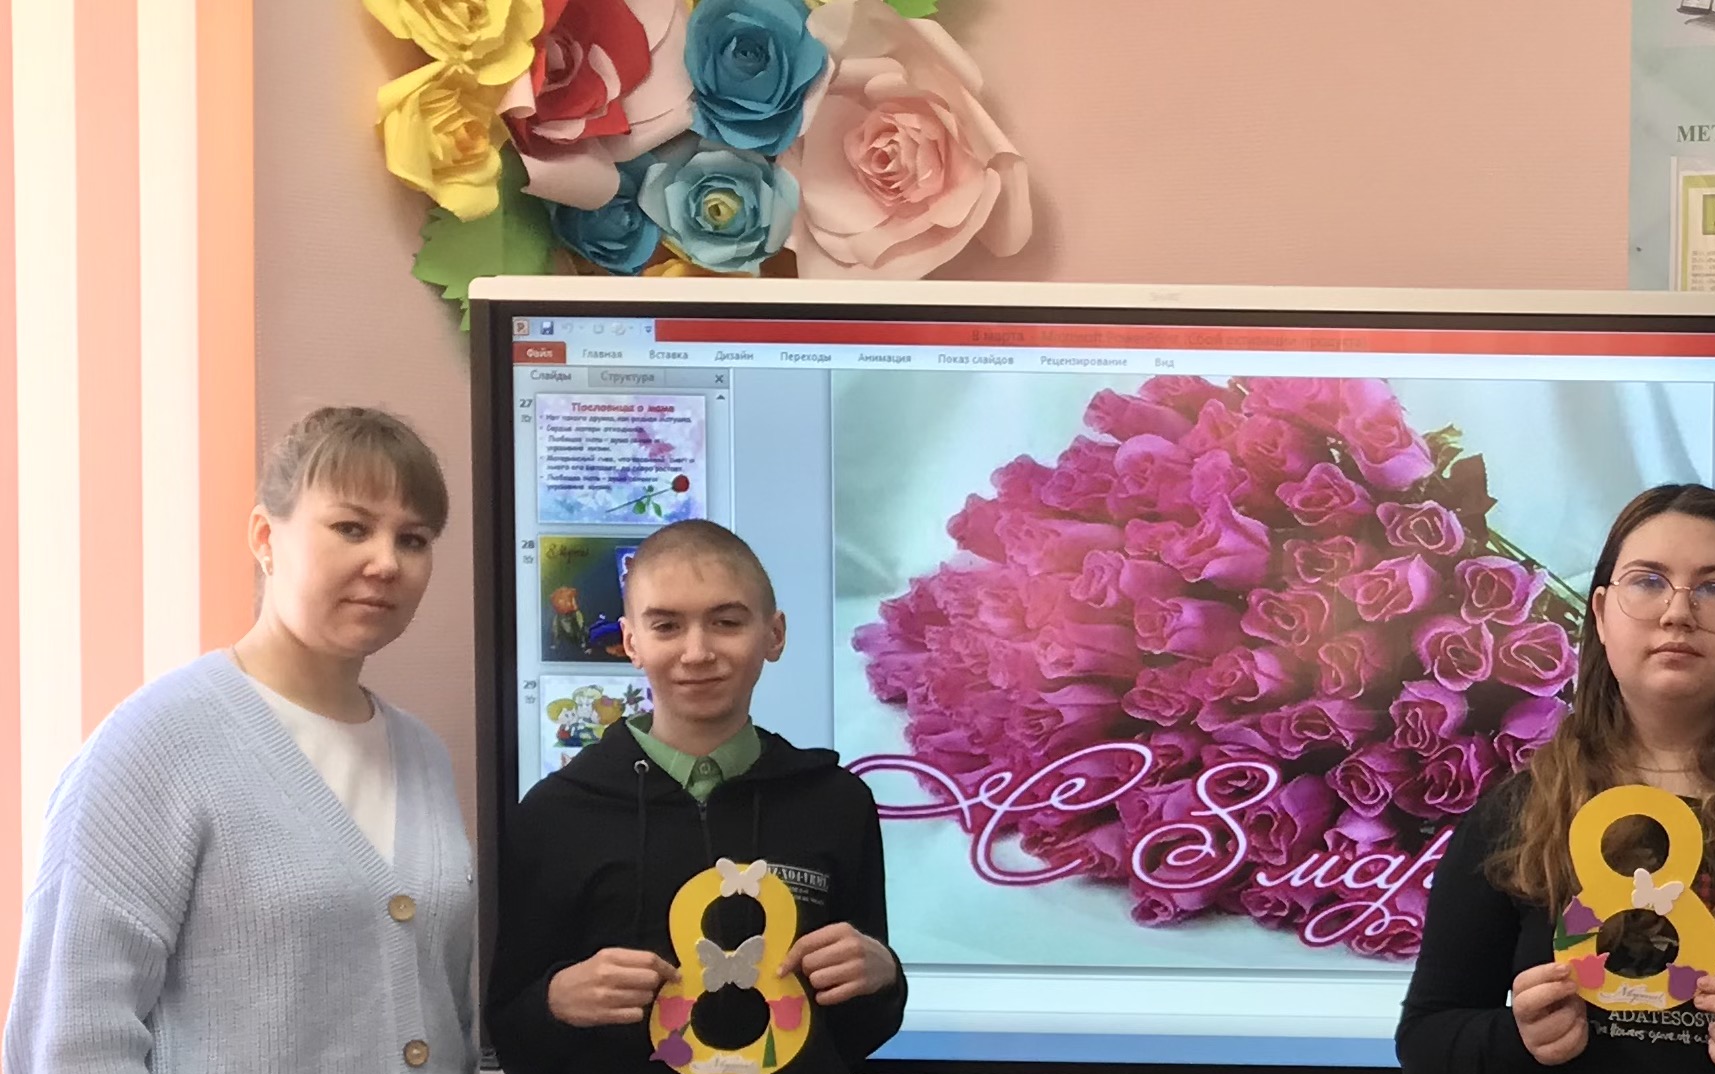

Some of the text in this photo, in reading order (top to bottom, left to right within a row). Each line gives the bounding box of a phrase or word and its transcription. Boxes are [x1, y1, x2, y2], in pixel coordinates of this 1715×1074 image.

[526, 347, 554, 359] Файл
[582, 348, 623, 360] Главная
[649, 349, 689, 361] Вставка
[714, 350, 754, 362] Дизайн
[780, 351, 832, 363] Переходы
[857, 352, 912, 364] Анимация
[938, 354, 1014, 366] Показ слайдов
[1040, 355, 1128, 367] Рецензирование
[1155, 357, 1175, 368] Вид
[530, 369, 572, 382] Слайды
[600, 370, 655, 384] Структура
[519, 398, 533, 408] 27
[521, 540, 535, 549] 28
[523, 680, 537, 690] 29
[1131, 761, 1279, 890] 8
[1256, 829, 1454, 946] мар
